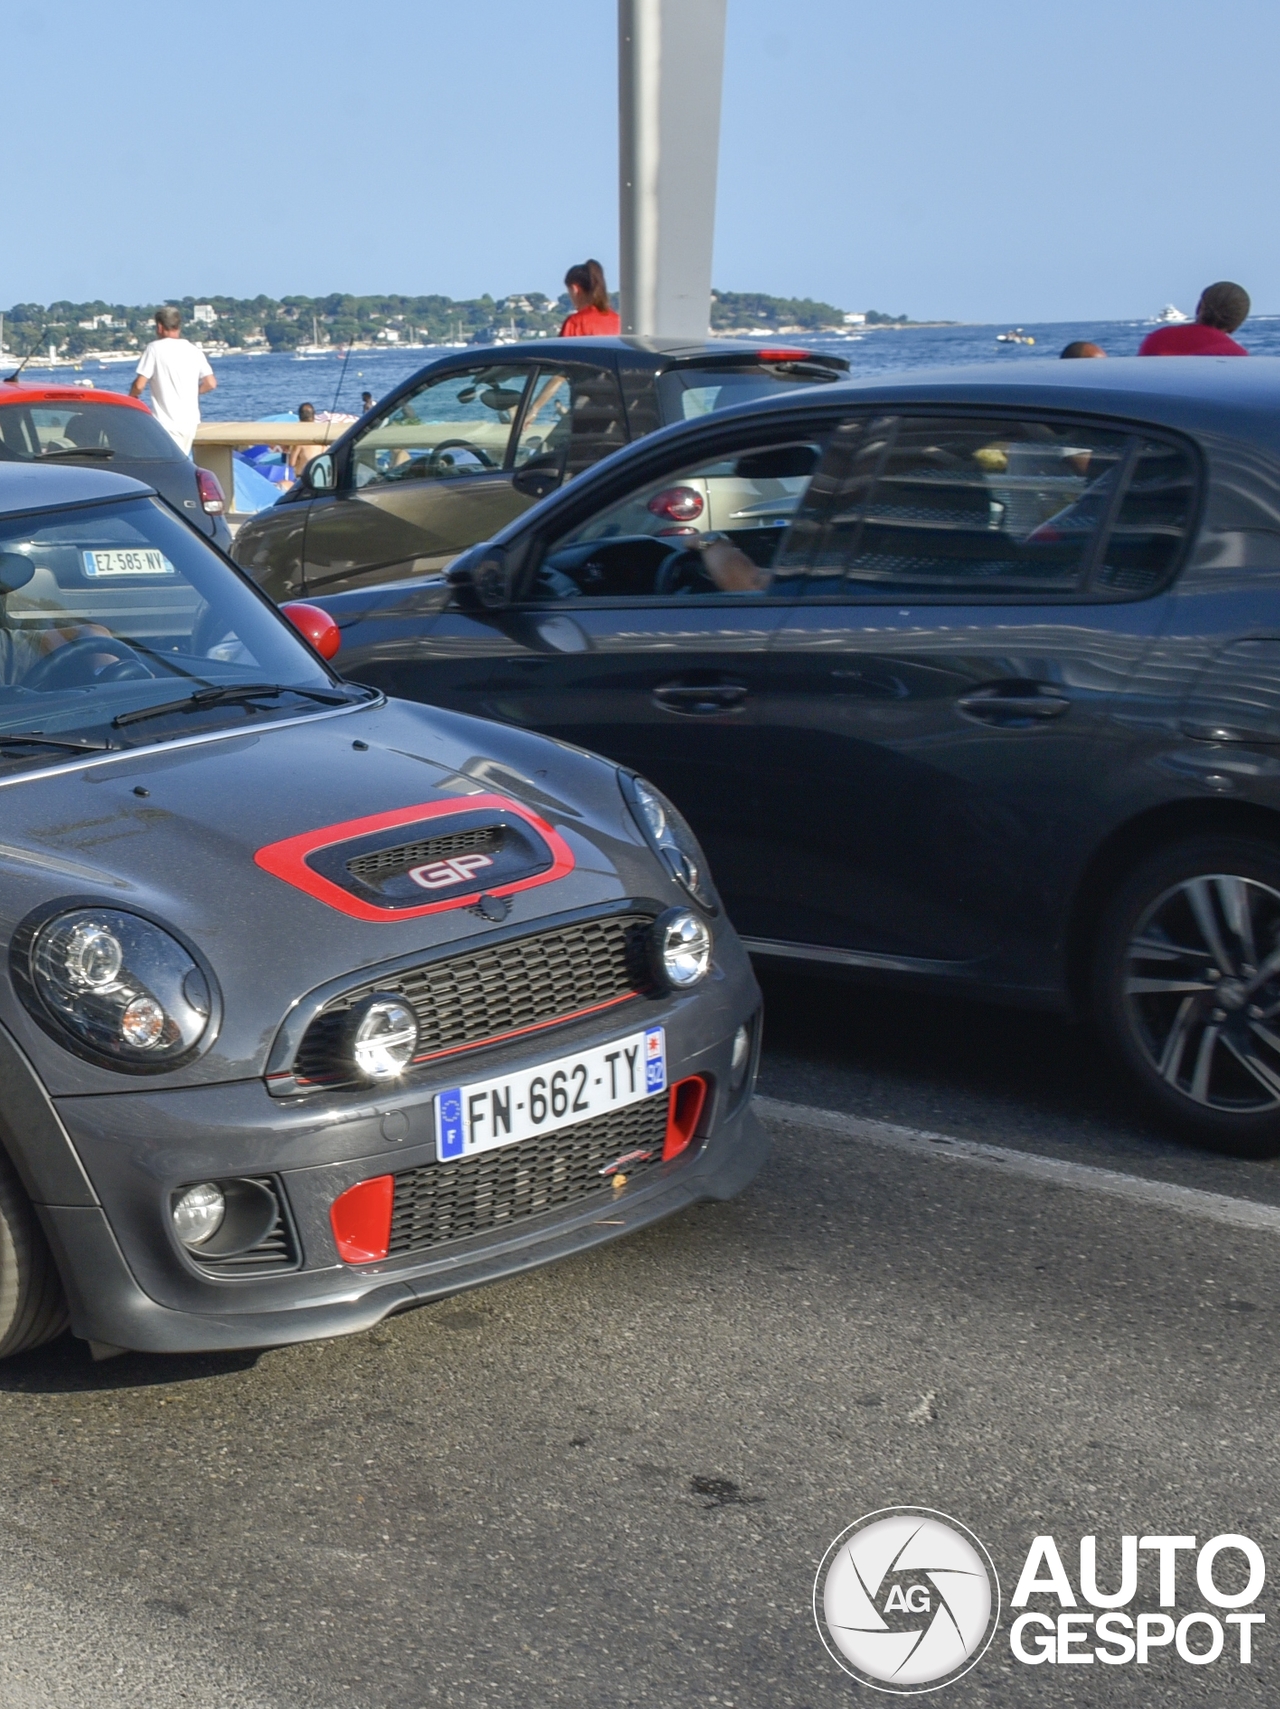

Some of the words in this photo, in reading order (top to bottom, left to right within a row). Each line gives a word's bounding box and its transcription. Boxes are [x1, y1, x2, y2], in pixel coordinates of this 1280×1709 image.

[408, 854, 494, 889] GP
[447, 1130, 457, 1144] F
[468, 1044, 639, 1144] FN-662-TY
[646, 1062, 663, 1085] 92
